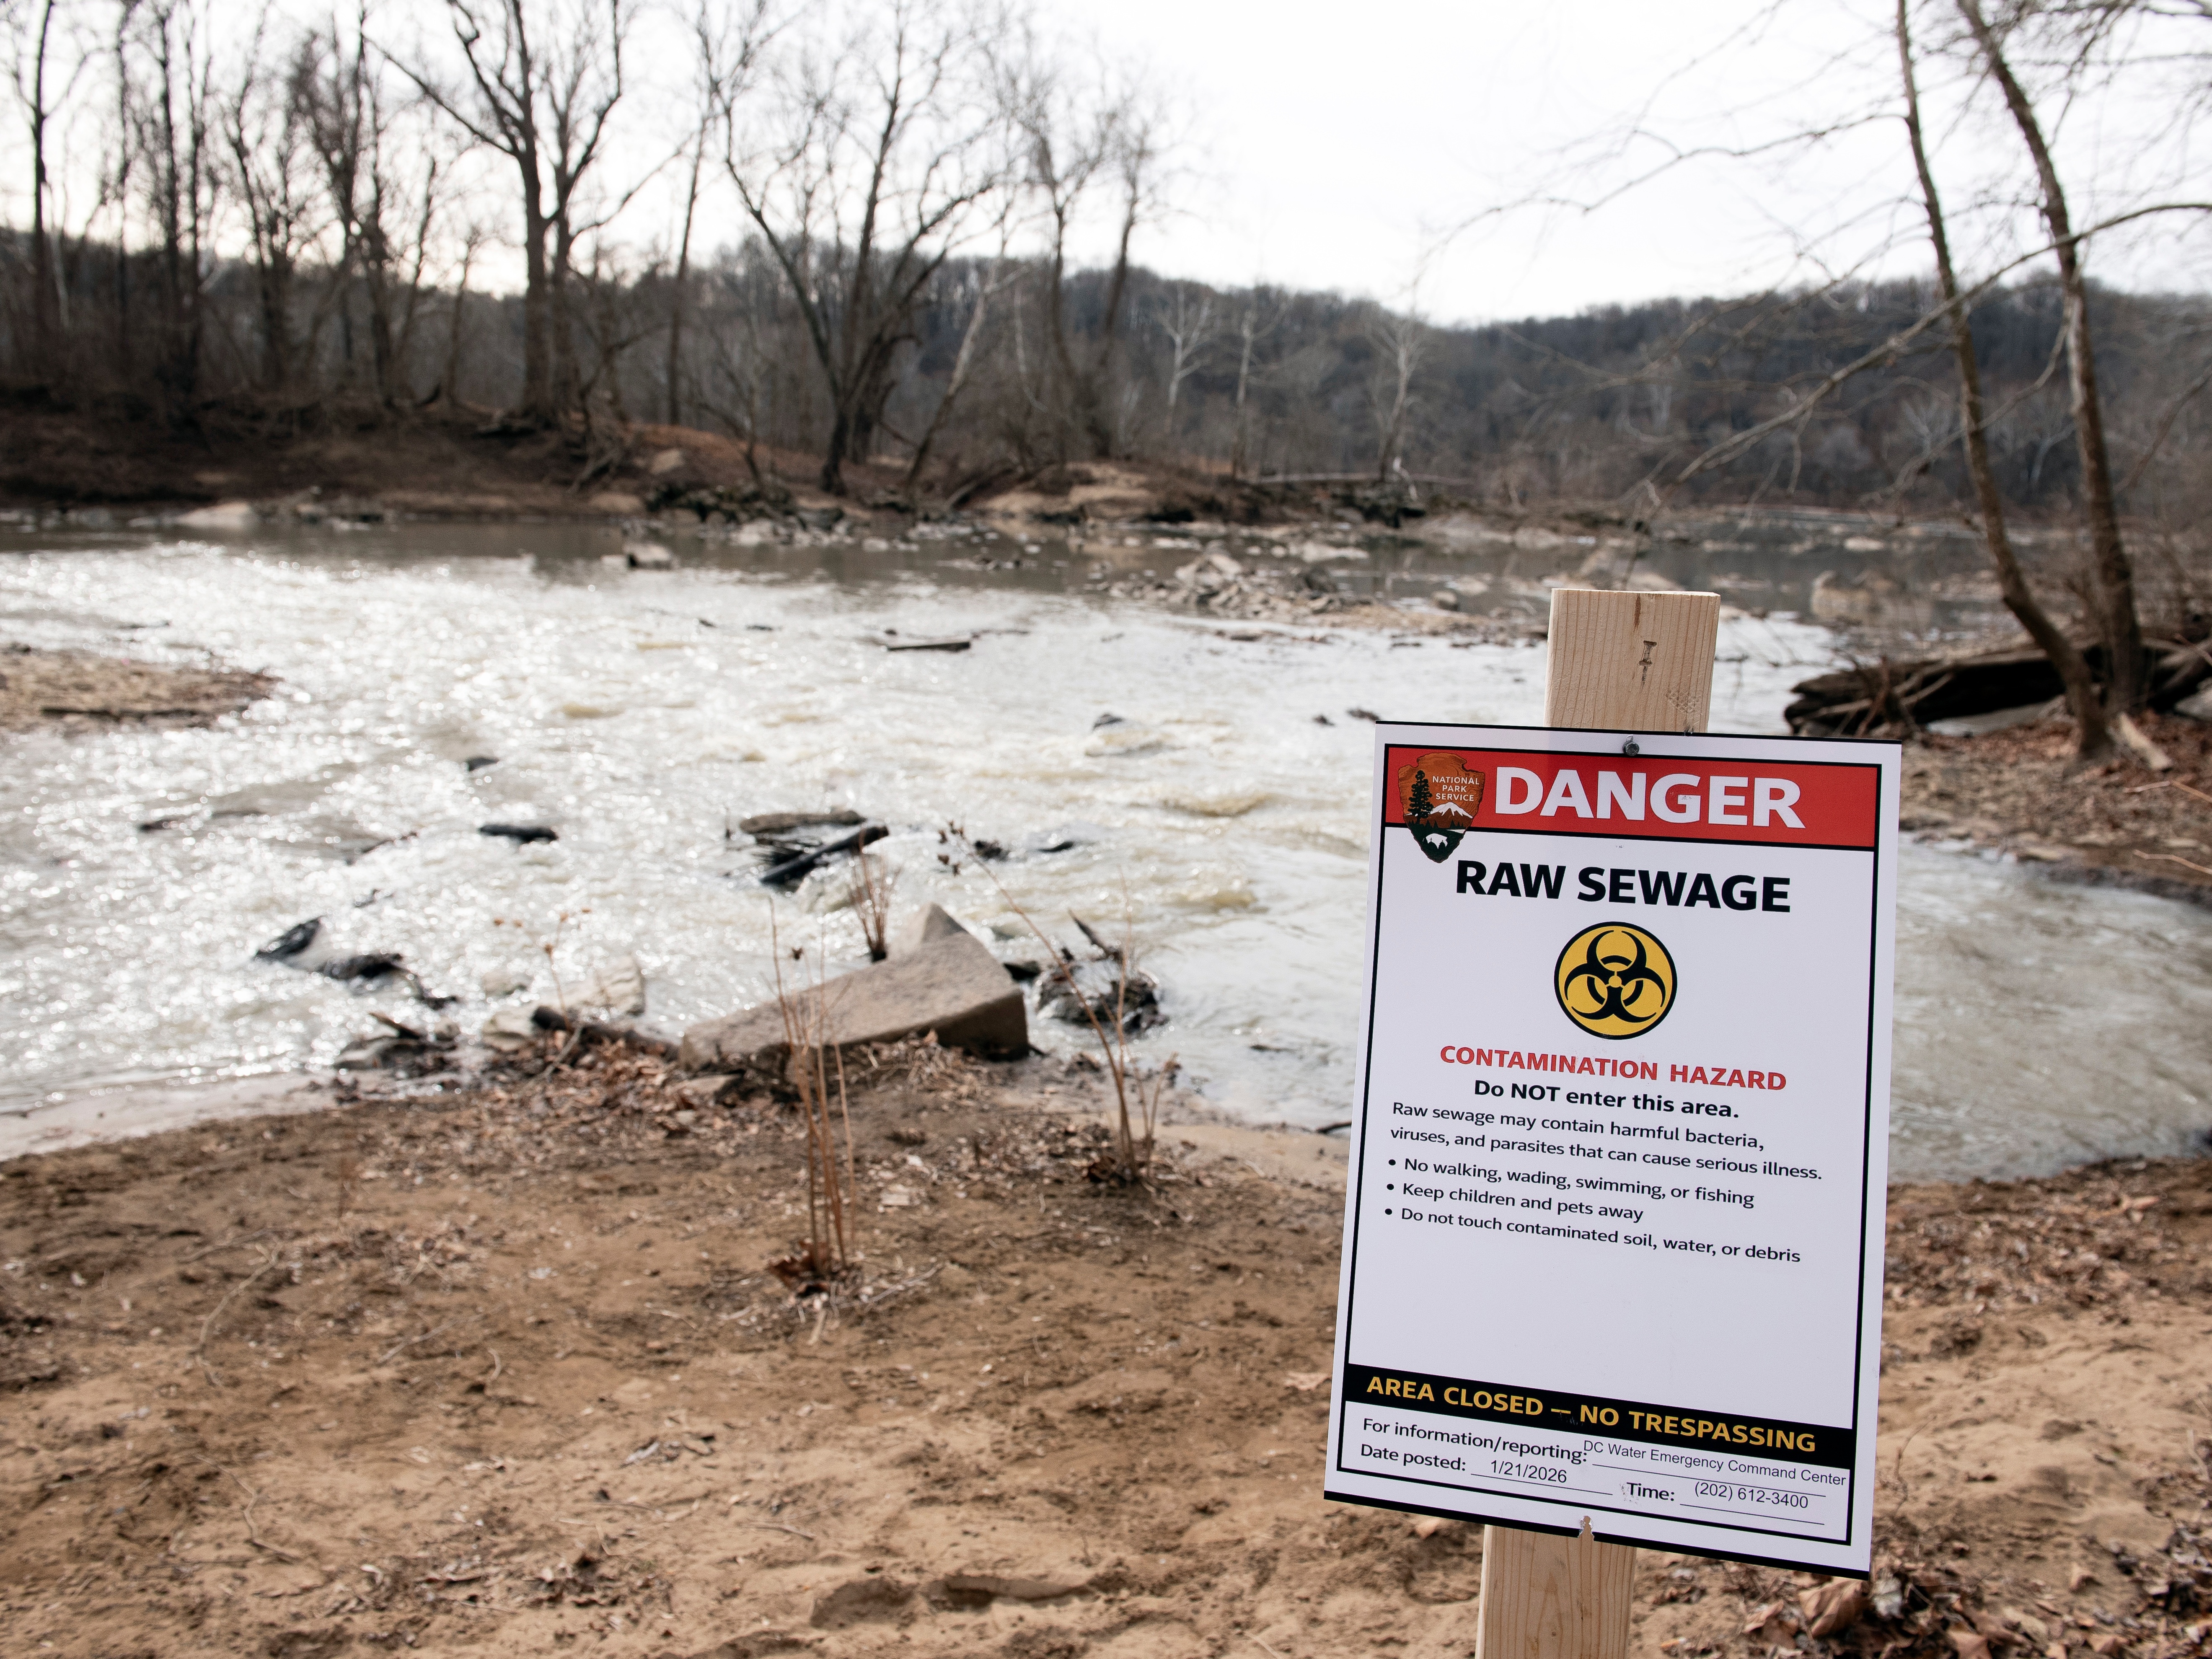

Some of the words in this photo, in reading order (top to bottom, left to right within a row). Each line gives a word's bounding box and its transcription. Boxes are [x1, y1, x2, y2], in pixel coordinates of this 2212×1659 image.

[1433, 776, 1480, 785] NATIONAL
[1436, 793, 1474, 801] SERVICE
[1495, 766, 1806, 828] DANGER
[1456, 859, 1566, 899] RAW
[1577, 866, 1790, 913] SEWAGE
[1441, 1046, 1658, 1080] CONTAMINATION
[1671, 1064, 1786, 1090] HAZARD
[1475, 1079, 1504, 1097] Do
[1511, 1083, 1561, 1102] NOT
[1566, 1091, 1627, 1108] enter
[1632, 1093, 1674, 1112] this
[1681, 1102, 1739, 1118] area.
[1393, 1102, 1428, 1117] Raw
[1432, 1109, 1495, 1126] sewage
[1500, 1115, 1537, 1131] may
[1541, 1119, 1604, 1134] contain
[1610, 1121, 1679, 1141] harmful
[1686, 1128, 1764, 1152] bacteria,
[1390, 1127, 1449, 1147] viruses,
[1454, 1134, 1485, 1147] and
[1490, 1139, 1565, 1155] parasites
[1569, 1144, 1603, 1159] that
[1608, 1150, 1637, 1162] can
[1642, 1154, 1691, 1167] cause
[1696, 1157, 1758, 1173] serious
[1763, 1161, 1822, 1180] illness.
[1403, 1183, 1444, 1202] Keep
[1449, 1188, 1515, 1206] children
[1520, 1197, 1552, 1210] and
[1557, 1202, 1593, 1215] pets
[1598, 1206, 1644, 1223] away
[1405, 1158, 1428, 1172] No
[1433, 1162, 1502, 1183] walking,
[1507, 1171, 1571, 1190] wading,
[1576, 1177, 1666, 1200] swimming,
[1671, 1188, 1690, 1198] or
[1695, 1187, 1754, 1209] fishing
[1402, 1208, 1423, 1221] Do
[1428, 1214, 1454, 1225] not
[1457, 1215, 1502, 1230] touch
[1506, 1222, 1618, 1243] contaminated
[1624, 1233, 1657, 1250] soil,
[1663, 1239, 1716, 1256] water,
[1721, 1245, 1741, 1256] or
[1745, 1245, 1801, 1262] debris
[1366, 1377, 1435, 1402] AREA
[1444, 1387, 1543, 1416] CLOSED
[1580, 1405, 1619, 1426] NO
[1629, 1411, 1816, 1452] TRESPASSING
[1361, 1444, 1399, 1461] Date
[1403, 1453, 1466, 1471] posted:
[1491, 1460, 1567, 1483] 1/21/2026
[1626, 1482, 1675, 1501] Time:
[1695, 1481, 1733, 1501] (202)
[1738, 1487, 1808, 1509] 612-3400
[1363, 1418, 1390, 1434] For
[1395, 1422, 1587, 1465] information/reporting:
[1584, 1440, 1604, 1453] DC
[1608, 1443, 1647, 1459] Water
[1651, 1449, 1724, 1472] Emergency
[1728, 1460, 1796, 1479] Command
[1801, 1470, 1846, 1486] Center
